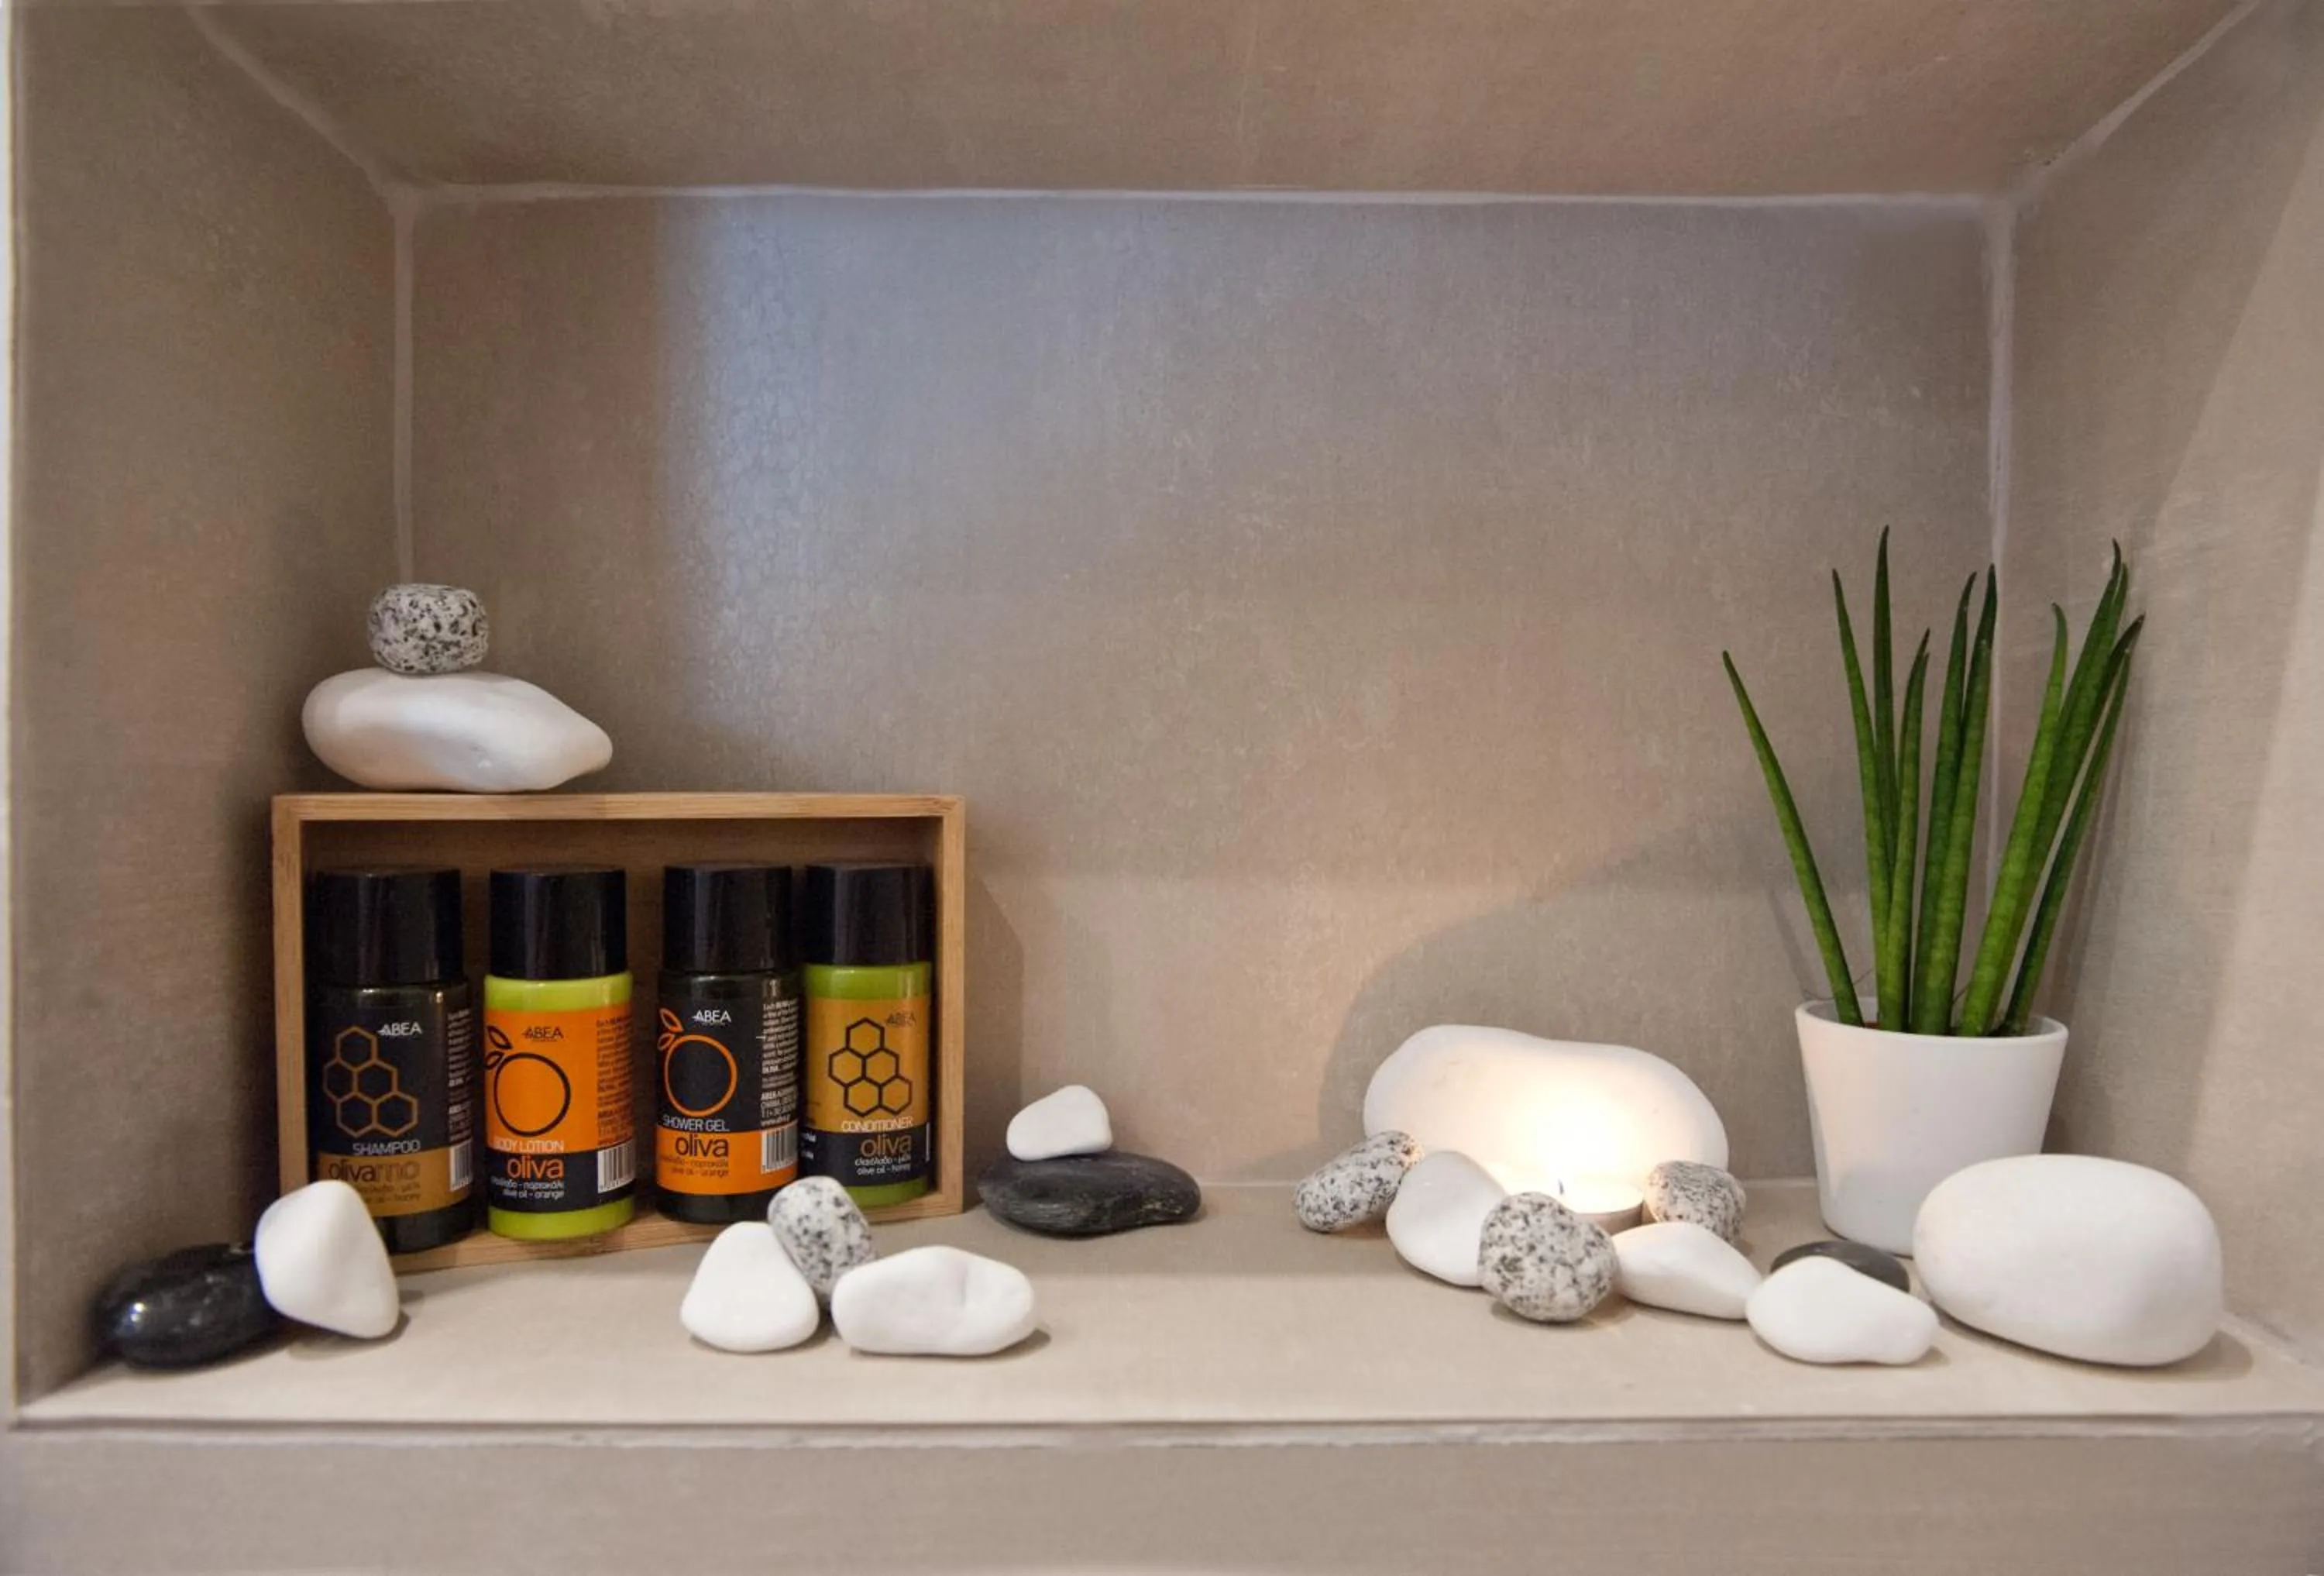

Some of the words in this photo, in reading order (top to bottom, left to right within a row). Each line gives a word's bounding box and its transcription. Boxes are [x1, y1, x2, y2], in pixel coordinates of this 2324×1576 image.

[692, 1010, 731, 1023] ABEA
[379, 1022, 422, 1036] ABEA
[521, 1025, 564, 1039] ABEA
[662, 1113, 703, 1131] SHOWER
[706, 1119, 731, 1132] GEL
[841, 1116, 913, 1133] CONDITIONER
[352, 1139, 421, 1155] SHAMPOO
[493, 1136, 517, 1151] BODY
[520, 1140, 564, 1154] LOTION
[676, 1134, 728, 1157] oliva
[860, 1134, 913, 1158] oliva
[507, 1154, 564, 1179] oliva
